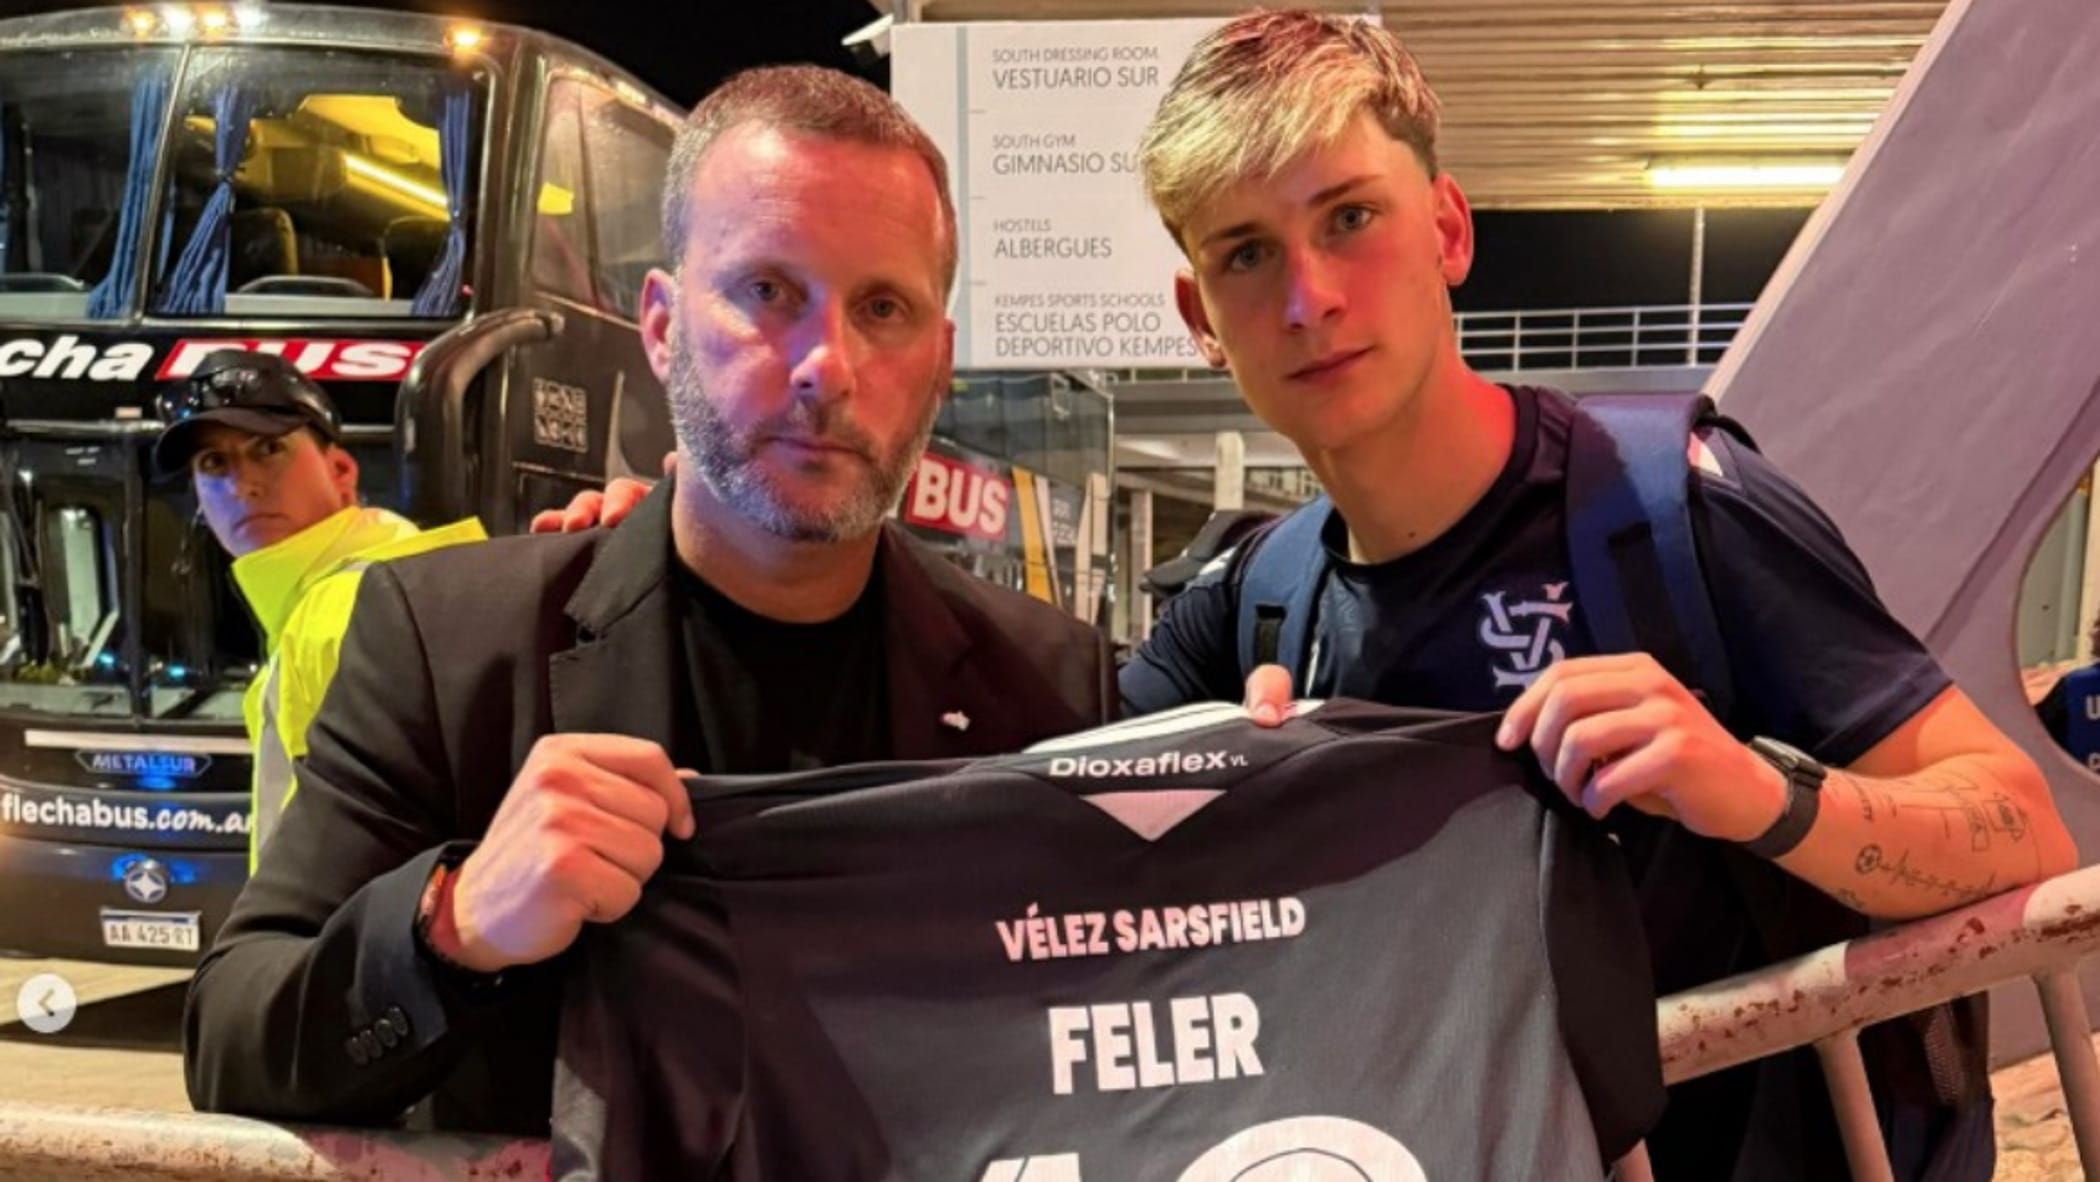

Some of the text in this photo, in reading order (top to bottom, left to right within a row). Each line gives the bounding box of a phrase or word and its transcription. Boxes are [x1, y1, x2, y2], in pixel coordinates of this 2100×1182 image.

[992, 46, 1158, 63] SOUTH DRESSING ROOM
[992, 66, 1159, 89] VESTUARIO SUR
[992, 134, 1076, 149] SOUTH GYM
[992, 152, 1105, 175] GIMNASIO
[993, 218, 1052, 232] HOSTELS
[994, 237, 1112, 259] ALBERGUES
[994, 292, 1165, 308] KEMPES SPORTS SCHOOLS
[995, 311, 1161, 333] ESCUELAS POLO
[996, 335, 1198, 358] DEPORTIVO KEMPES
[912, 458, 1007, 534] BUS
[1049, 751, 1249, 777] Dioxaflex VL
[109, 924, 131, 942] AA
[137, 925, 170, 944] 425
[996, 897, 1306, 960] VÉLEZ SARSFIELD
[1048, 992, 1264, 1095] FELER
